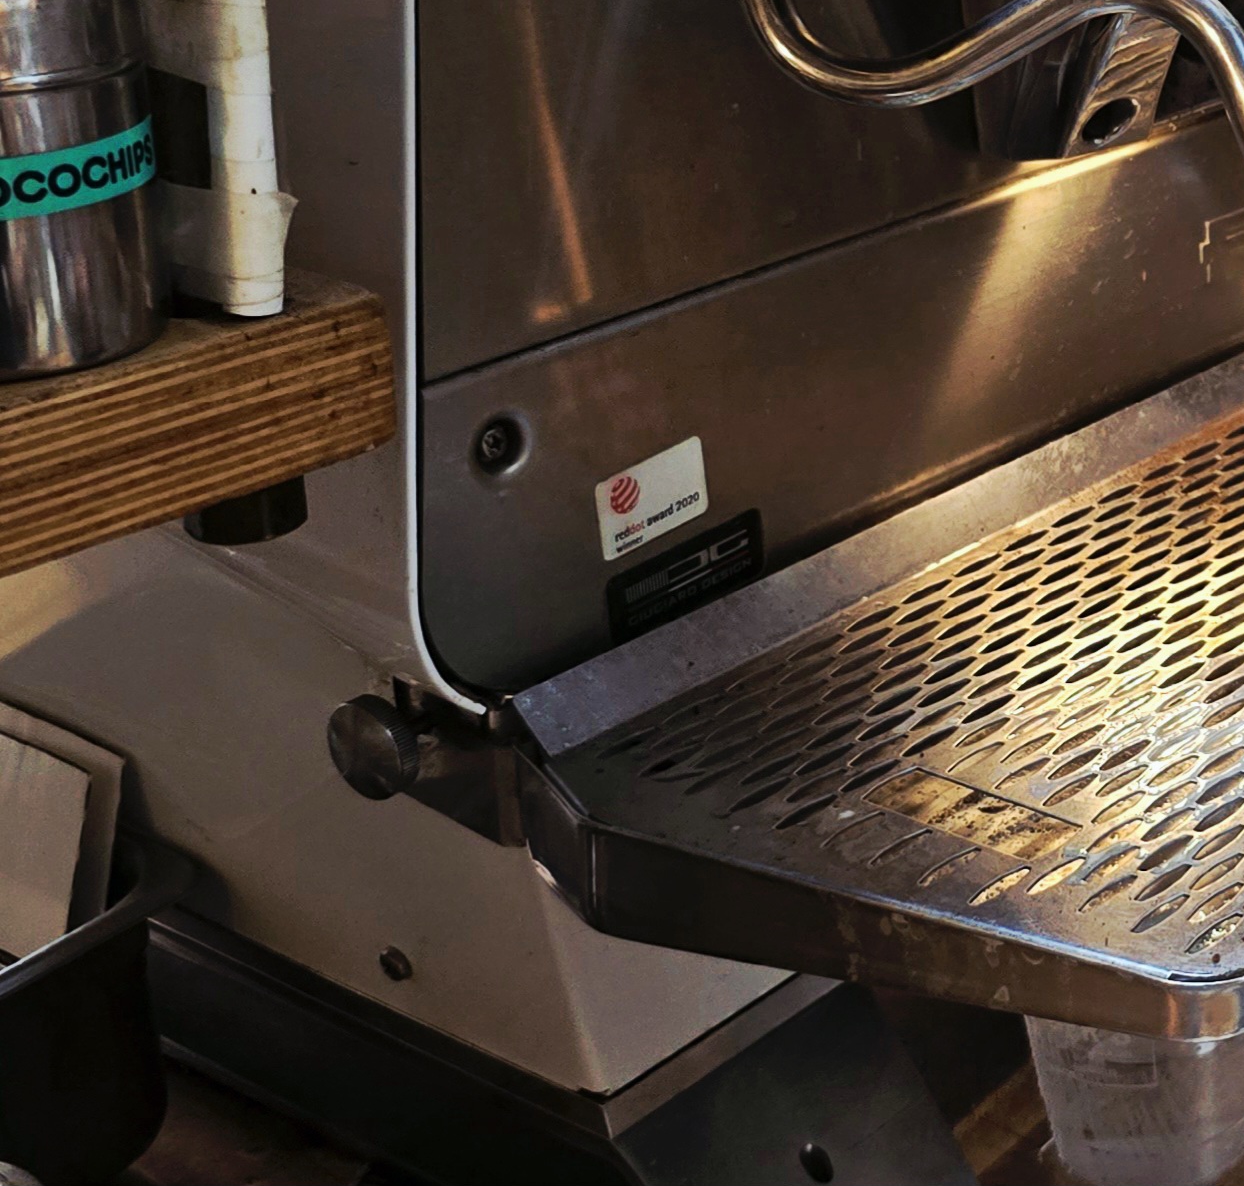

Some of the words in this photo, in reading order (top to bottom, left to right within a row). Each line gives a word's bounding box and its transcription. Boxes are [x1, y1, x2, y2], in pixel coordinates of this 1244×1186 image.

[646, 504, 674, 526] award
[675, 492, 700, 512] 2020
[701, 557, 752, 589] DESIGN
